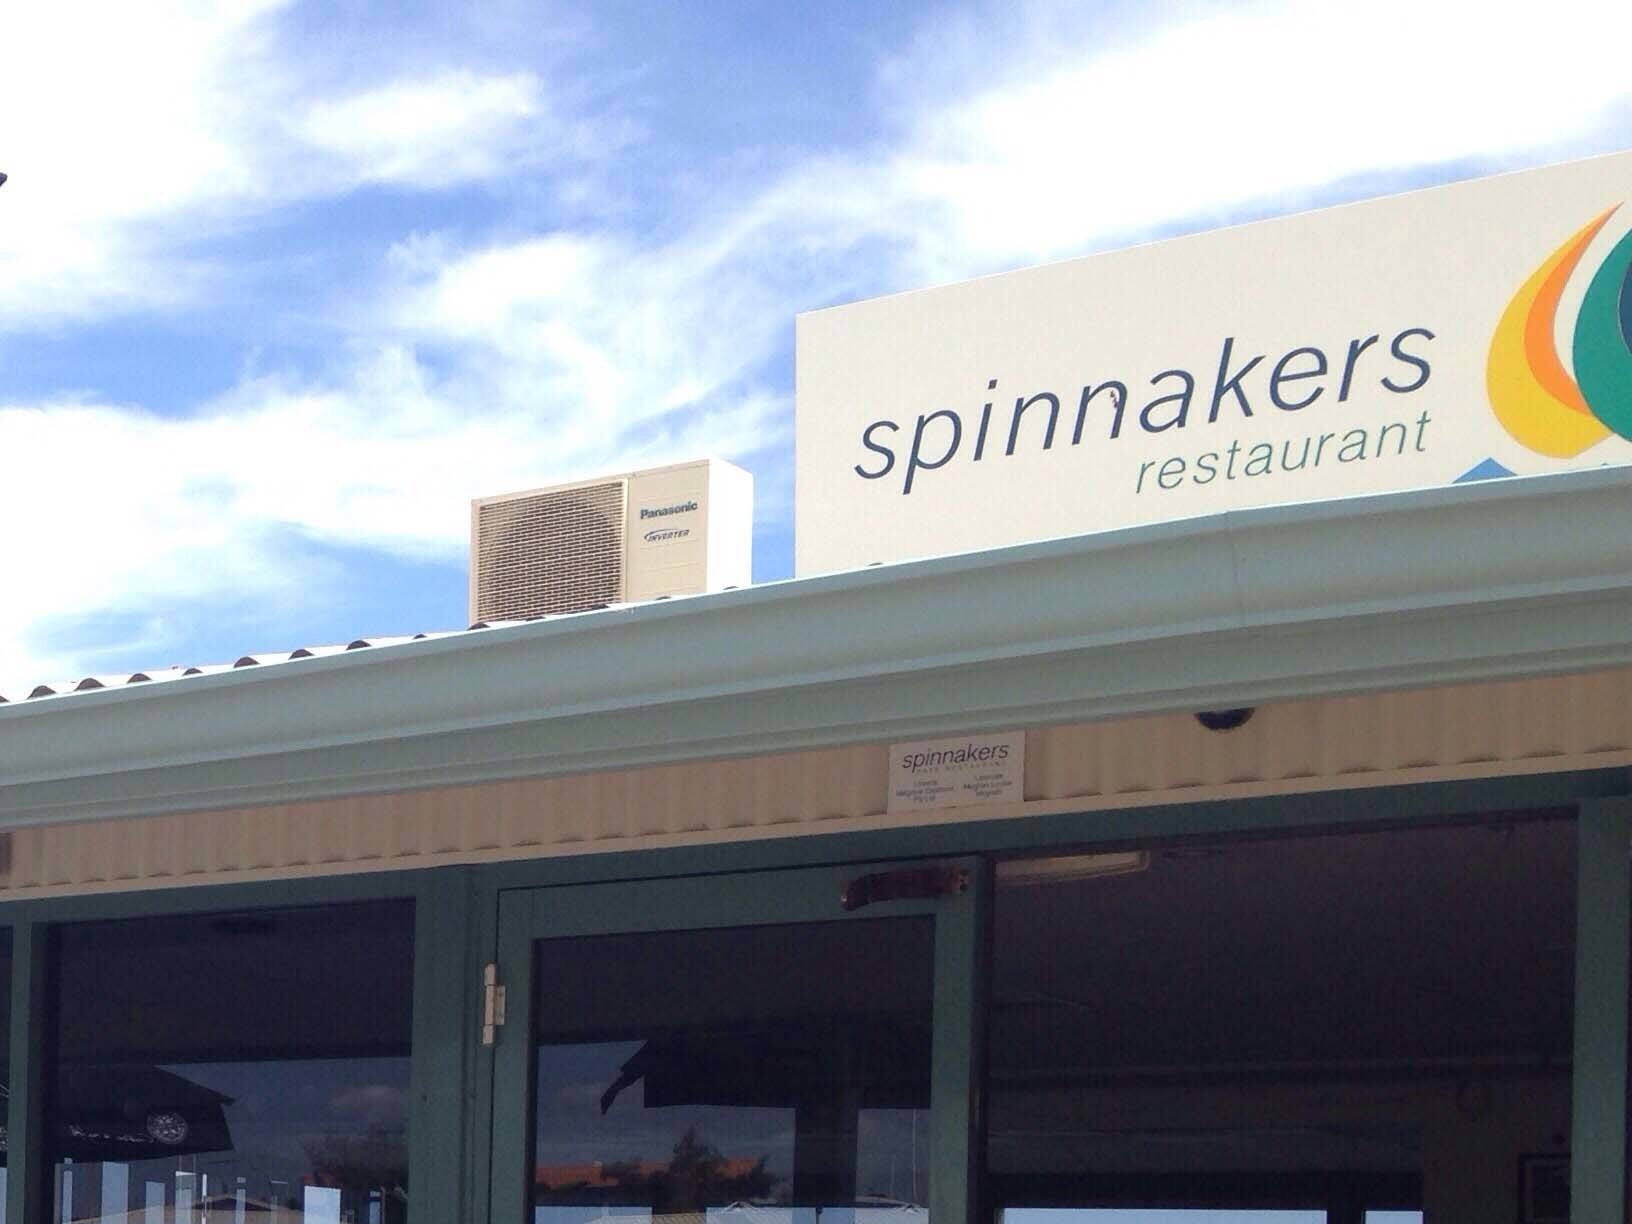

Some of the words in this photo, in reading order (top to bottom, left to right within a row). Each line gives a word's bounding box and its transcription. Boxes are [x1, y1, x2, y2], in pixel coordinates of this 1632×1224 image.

[854, 327, 1437, 496] spinnakers
[1135, 410, 1433, 495] restaurant
[640, 500, 699, 520] Panasonic
[647, 529, 690, 542] INVERTER
[902, 744, 1009, 773] spinnakers
